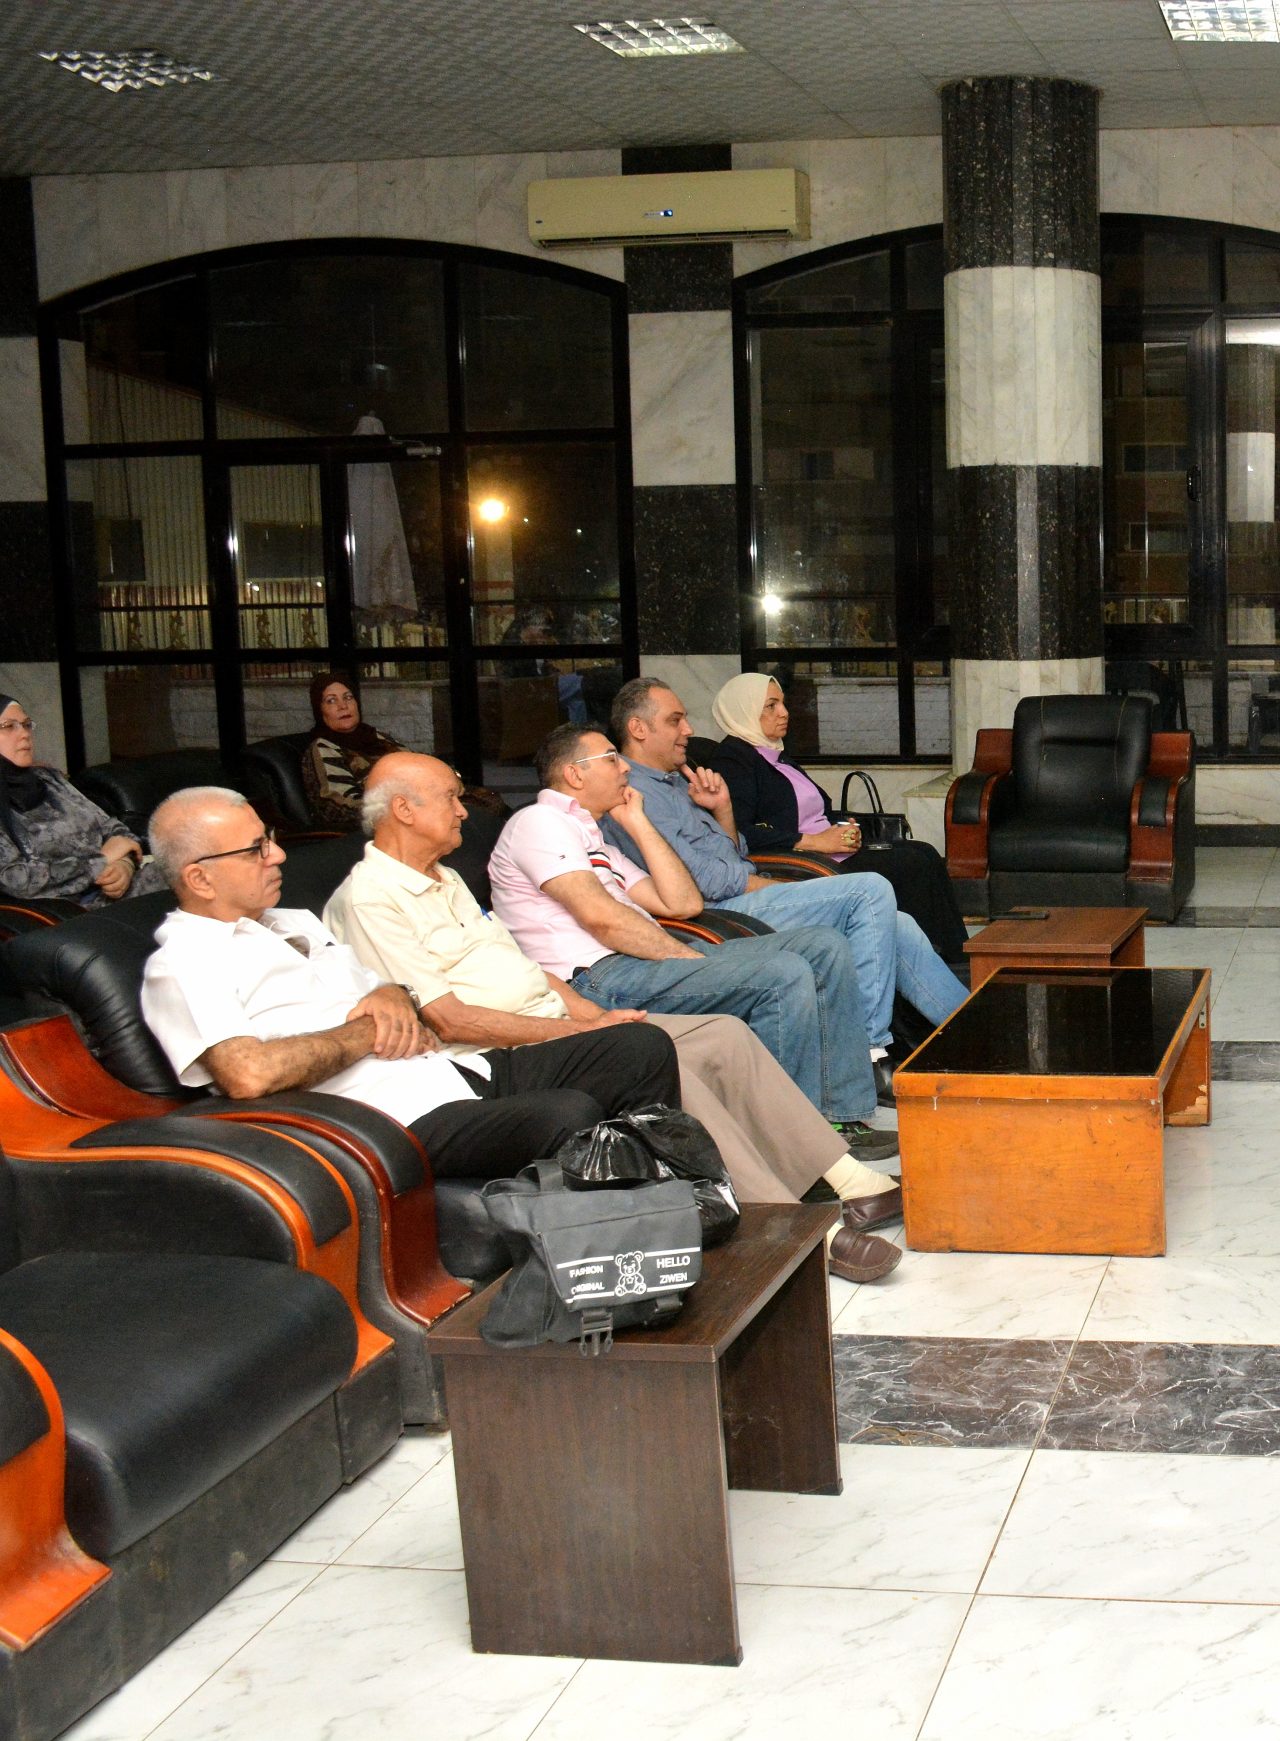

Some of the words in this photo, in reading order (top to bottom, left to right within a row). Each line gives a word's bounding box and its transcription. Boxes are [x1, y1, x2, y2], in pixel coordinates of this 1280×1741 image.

[656, 1255, 691, 1269] HELLO
[569, 1264, 604, 1278] FASHION
[659, 1272, 688, 1284] ZIWEN
